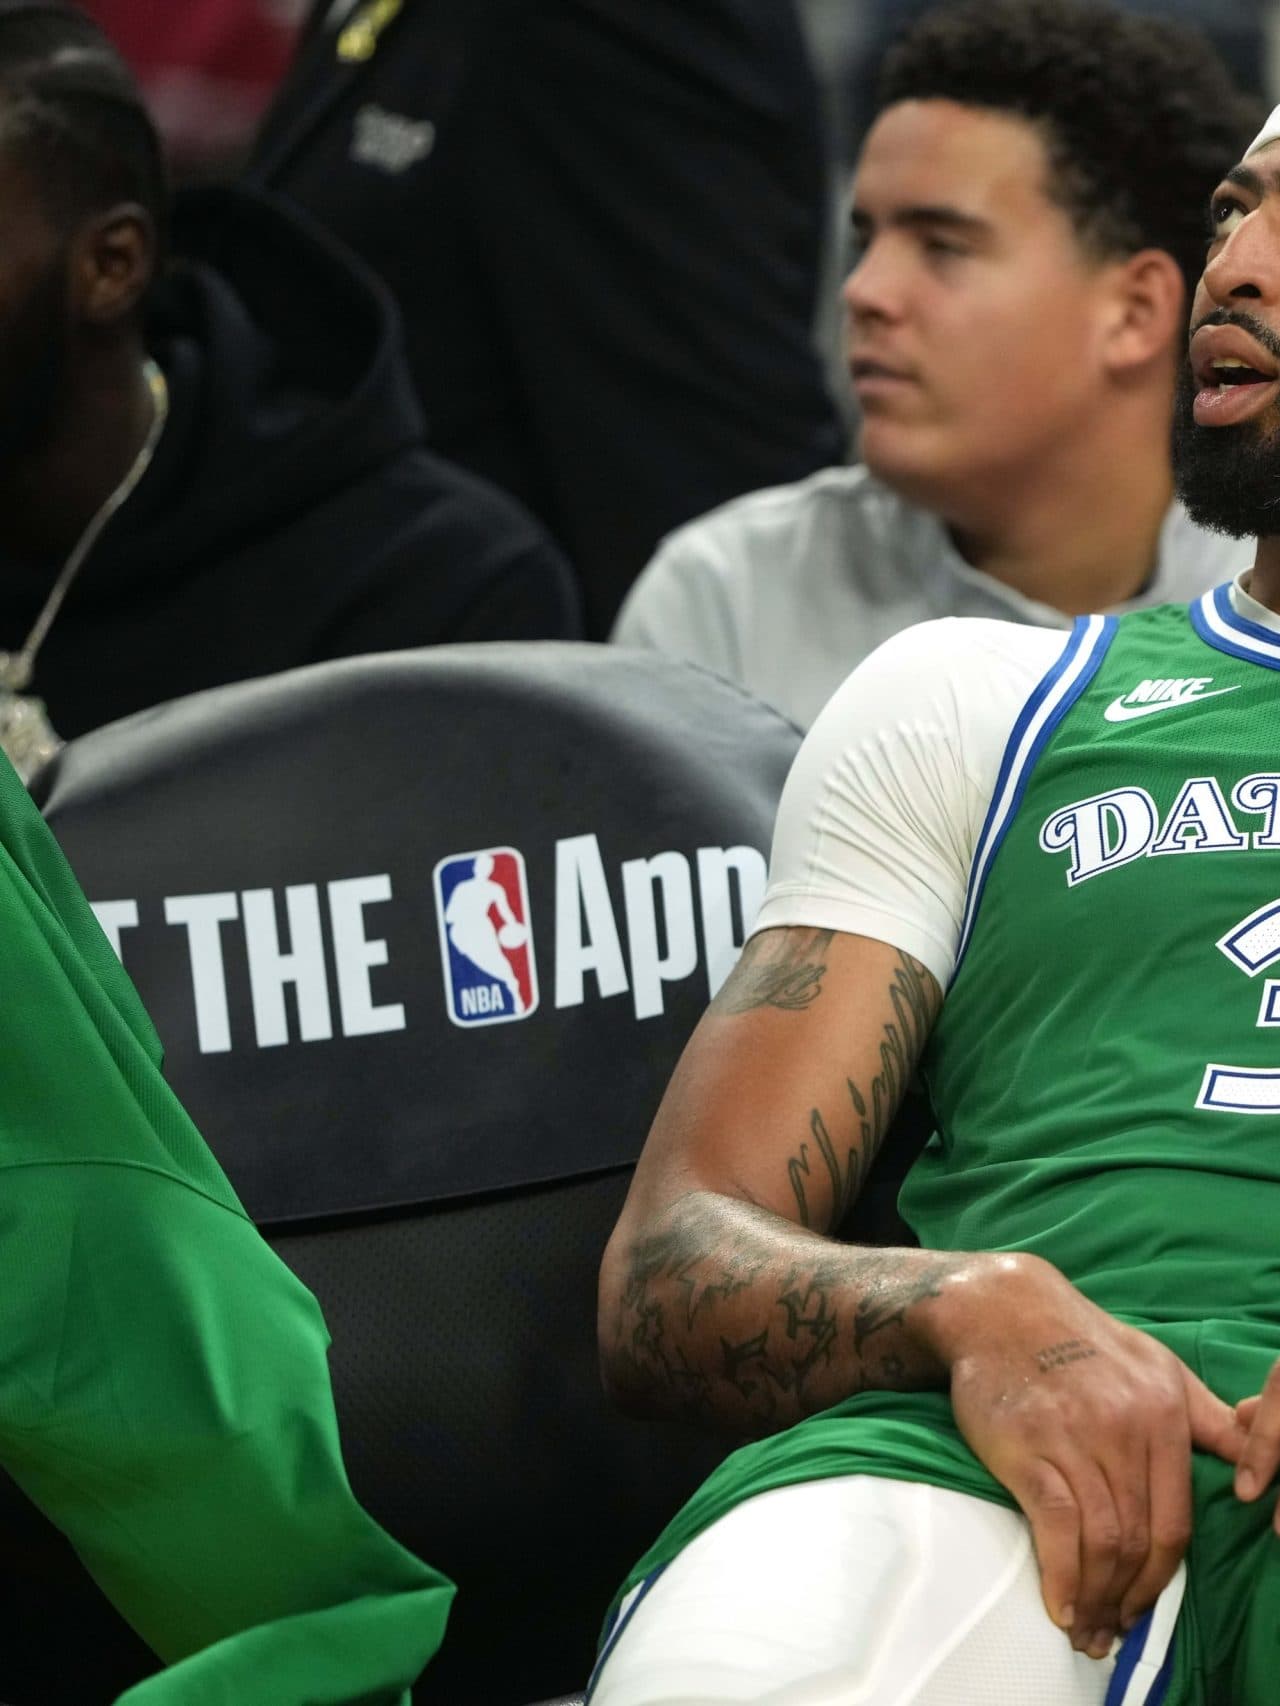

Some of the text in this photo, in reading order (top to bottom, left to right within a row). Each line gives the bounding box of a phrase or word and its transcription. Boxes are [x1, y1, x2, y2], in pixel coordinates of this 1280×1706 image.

[1124, 677, 1214, 704] NIKE
[164, 833, 768, 1054] THE NBA App
